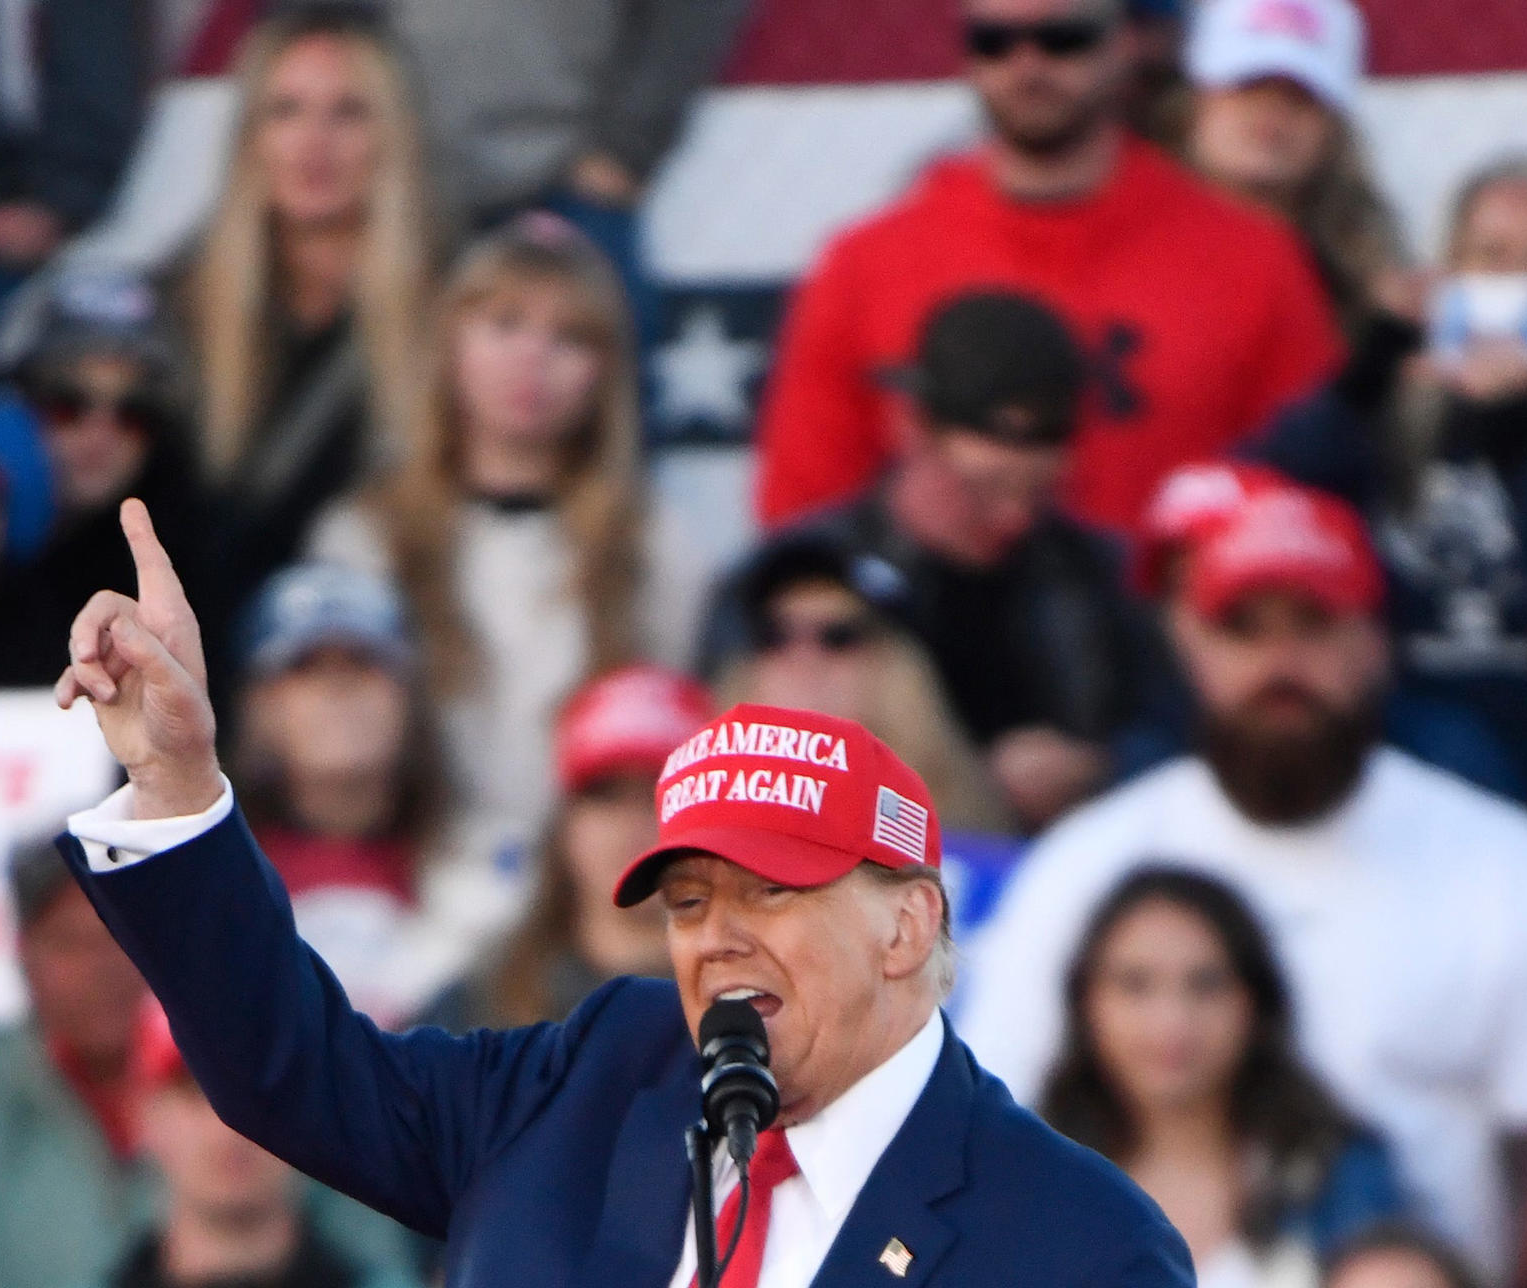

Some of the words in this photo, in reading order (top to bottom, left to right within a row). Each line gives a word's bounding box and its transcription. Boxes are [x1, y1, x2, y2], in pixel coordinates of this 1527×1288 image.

[710, 721, 849, 772] AMERICA
[660, 769, 728, 824] GREAT
[725, 769, 828, 815] AGAIN
